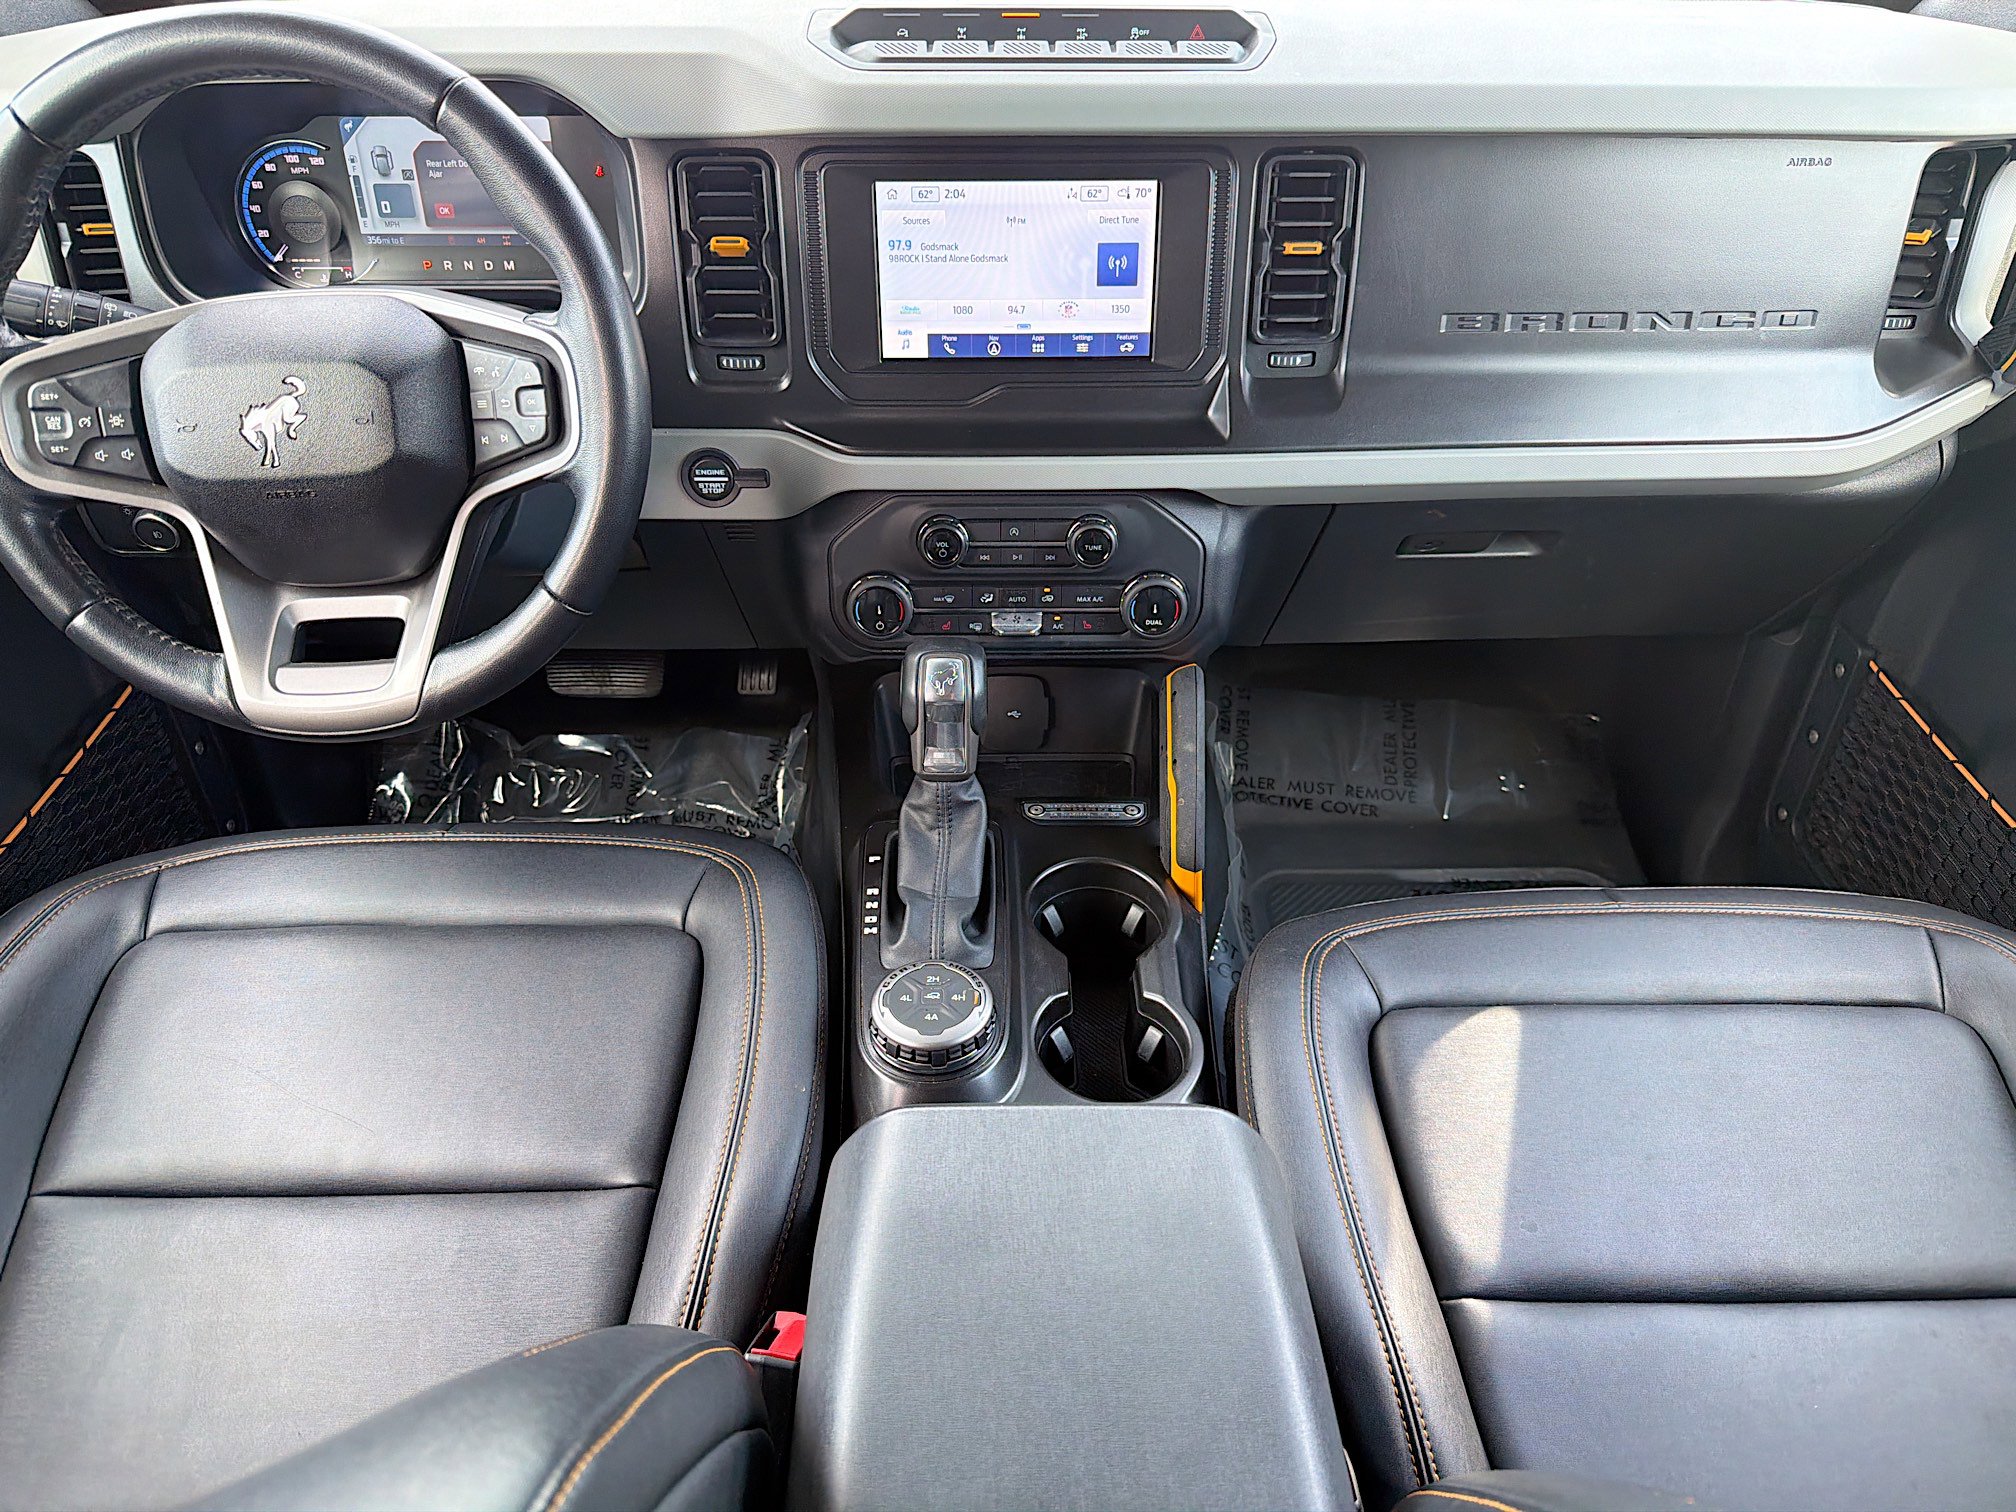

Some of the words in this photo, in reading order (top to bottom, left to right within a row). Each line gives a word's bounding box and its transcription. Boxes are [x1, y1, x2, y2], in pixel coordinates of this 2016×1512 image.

[284, 155, 299, 163] 100
[309, 157, 324, 165] 120
[426, 159, 442, 168] Rear
[442, 159, 457, 168] Left
[1786, 157, 1832, 167] AIRBAG
[429, 169, 443, 179] Ajar
[252, 181, 263, 189] 60
[918, 189, 933, 199] 62°
[944, 188, 966, 199] 2:04
[1087, 189, 1102, 198] 62°
[1135, 188, 1152, 198] 70°
[250, 205, 261, 213] 40
[439, 206, 450, 215] OK
[903, 216, 931, 226] Sources
[1099, 215, 1119, 225] Direct
[1121, 215, 1139, 225] Tune
[258, 230, 269, 238] 20
[888, 239, 912, 251] 97.9
[920, 242, 959, 252] Godsmack
[888, 254, 920, 263] 98ROCK
[925, 254, 947, 263] Stand
[948, 254, 969, 263] Alone
[970, 254, 1009, 263] Godsmack
[422, 260, 433, 271] P
[443, 260, 454, 271] R
[463, 260, 474, 271] N
[484, 260, 494, 271] D
[504, 260, 515, 271] M
[345, 271, 352, 279] H
[953, 305, 973, 315] 1080
[1007, 305, 1026, 315] 94.7
[1111, 304, 1131, 314] 1350
[1439, 310, 1819, 334] BRONCO
[897, 328, 913, 336] Audio
[1031, 334, 1046, 343] Apps
[1071, 334, 1094, 343] Settings
[1116, 334, 1139, 342] Features
[40, 393, 59, 401] SET+
[526, 398, 536, 406] OK
[1217, 685, 1233, 734] COVER
[1233, 709, 1250, 773] REMOVE
[1382, 732, 1397, 786] DEALER
[1287, 781, 1334, 796] MUST
[1345, 784, 1418, 805] REMOVE
[1320, 800, 1379, 818] COVER
[866, 887, 880, 896] R
[865, 901, 879, 909] N
[863, 926, 878, 935] M
[948, 962, 984, 988] MODES
